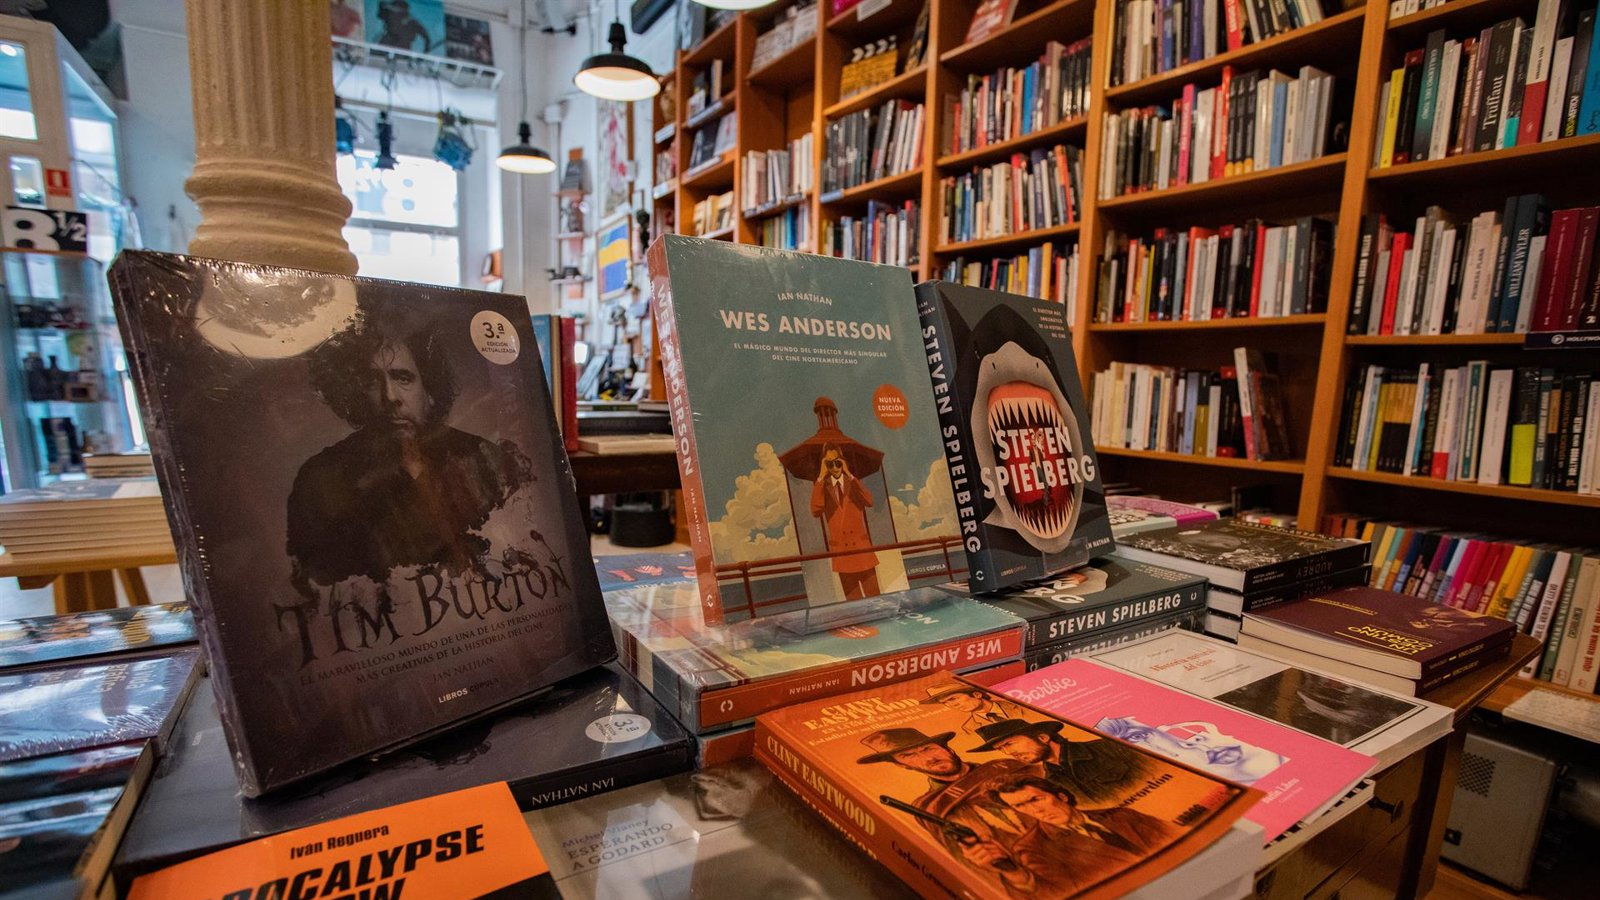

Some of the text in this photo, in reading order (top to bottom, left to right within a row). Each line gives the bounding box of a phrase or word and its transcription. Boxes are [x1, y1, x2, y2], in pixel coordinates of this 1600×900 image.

[1482, 75, 1504, 130] Truffaut
[1476, 248, 1486, 270] PLANA
[1508, 227, 1530, 298] WILLIAM WYLER
[777, 292, 833, 306] IAN NATHAN
[719, 309, 892, 341] WES ANDERSON
[733, 342, 742, 350] EL
[743, 342, 772, 351] MÁGICO
[773, 345, 799, 353] MUNDO
[812, 347, 842, 356] DIRECTOR
[858, 350, 887, 358] SINGULAR
[801, 356, 858, 365] NORTEAMERICANO
[657, 283, 694, 476] WES ANDERSON
[877, 404, 905, 412] EDICIÓN
[922, 325, 981, 554] STEVEN SPIELBERG
[998, 426, 1072, 461] STEVEN
[980, 455, 1096, 500] SPIELBERG
[1092, 537, 1111, 548] NATHAN
[907, 565, 926, 575] LIBROS
[1295, 561, 1332, 578] AUDREY
[272, 553, 571, 672] TIM BURTON
[1049, 593, 1182, 639] STEVEN SPIELBERG
[1568, 607, 1584, 639] CASABLANCA
[380, 654, 434, 678] CREATIVAS
[435, 649, 450, 660] DE
[451, 646, 464, 657] LA
[464, 633, 506, 653] HISTORIA
[508, 627, 524, 641] DEL
[524, 621, 544, 635] CINE
[1347, 625, 1432, 651] DESTINO
[1361, 624, 1434, 648] COMÚN
[1389, 643, 1419, 655] UN
[301, 675, 316, 686] EL
[318, 652, 396, 683] MARAVILLOSO
[397, 640, 439, 659] MUNDO
[439, 636, 453, 647] DE
[454, 629, 476, 642] UNA
[477, 625, 490, 636] DE
[491, 620, 506, 633] LAS
[851, 638, 1002, 687] WES ANDERSON
[431, 655, 495, 684] IAN NATHAN
[438, 687, 468, 704] LIBROS
[789, 679, 840, 696] IAN NATHAN
[1004, 675, 1077, 704] Barbie
[802, 697, 921, 731] EASTWOOD
[820, 696, 882, 718] CLINT
[808, 734, 847, 747] Estudio
[531, 777, 615, 807] IAN NATHAN
[766, 735, 801, 774] CLINT
[801, 766, 876, 837] EASTWOOD
[290, 824, 390, 860] Iván Reguera
[562, 817, 649, 849] Michel Vianey
[567, 822, 673, 860] ESPERANDO
[204, 824, 485, 900] OCALYPSE
[571, 835, 665, 871] A GODARD
